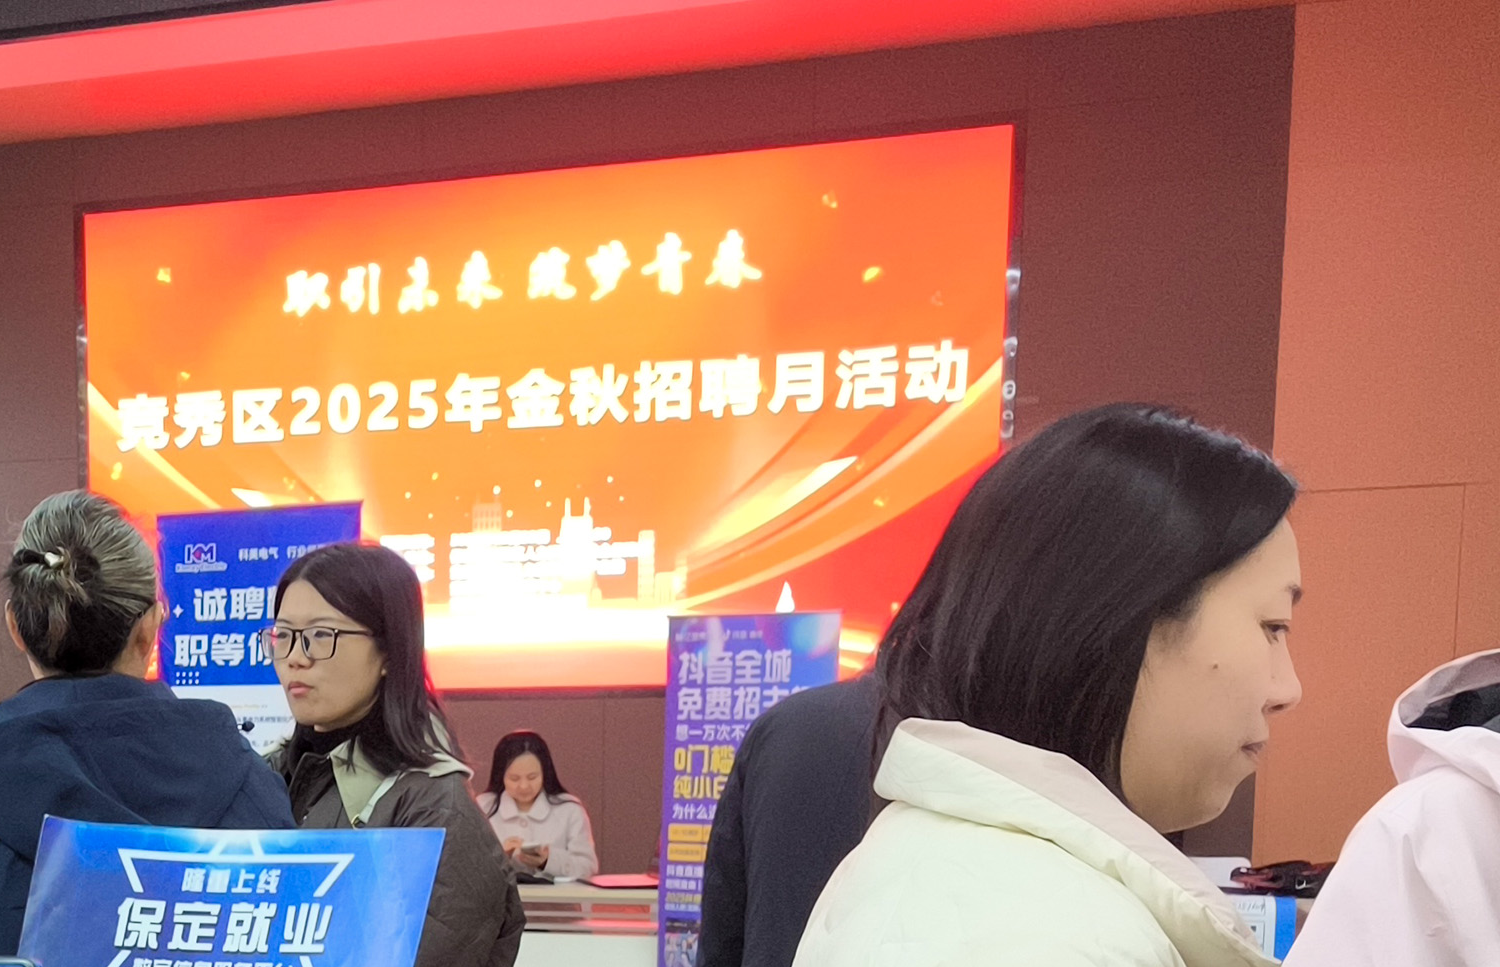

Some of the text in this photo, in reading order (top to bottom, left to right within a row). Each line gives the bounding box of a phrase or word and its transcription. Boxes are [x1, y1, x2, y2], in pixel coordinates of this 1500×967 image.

[283, 250, 503, 317] 职引未来
[117, 338, 970, 453] 竞秀区2025年金秋招聘月活动
[194, 586, 278, 622] 诚聘
[678, 648, 793, 685] 抖音全城
[181, 867, 281, 893] 隆重上线
[114, 897, 333, 954] 保定就业
